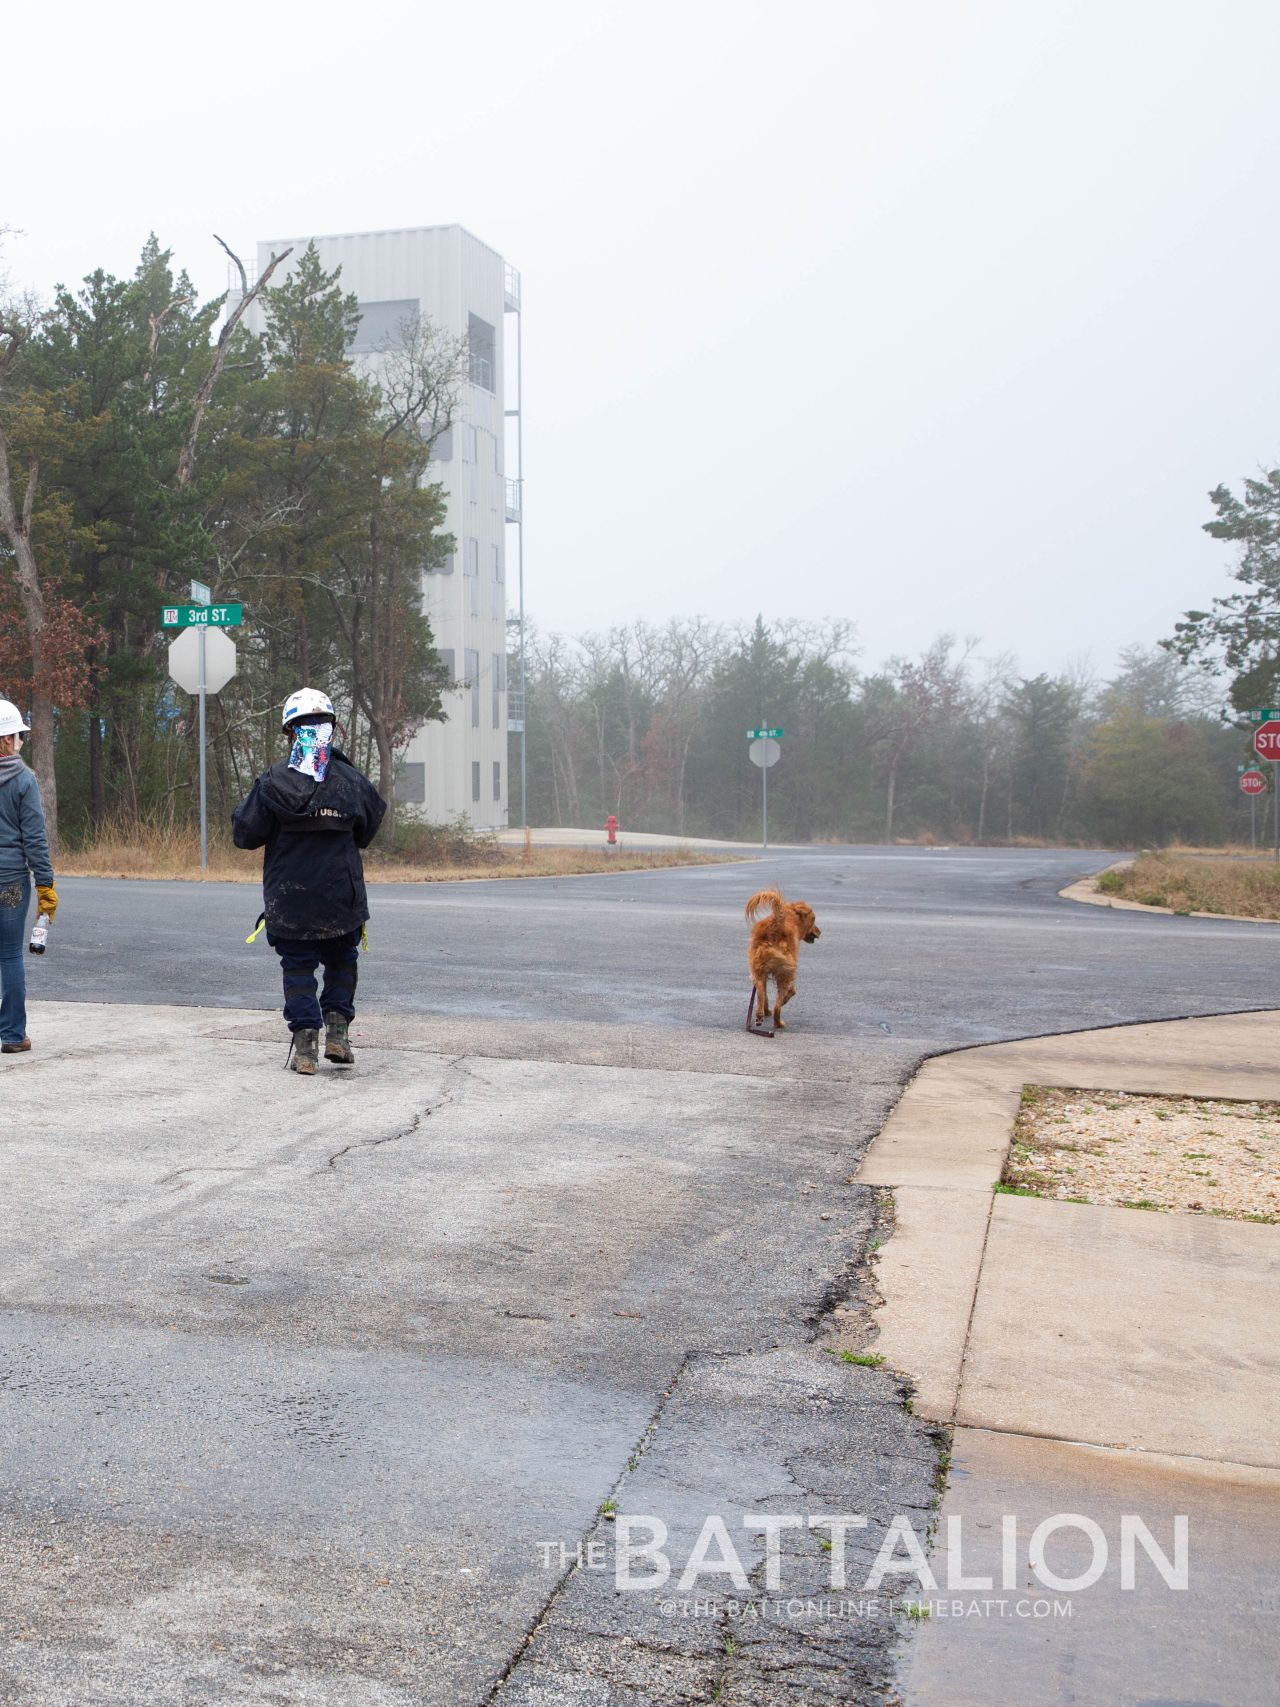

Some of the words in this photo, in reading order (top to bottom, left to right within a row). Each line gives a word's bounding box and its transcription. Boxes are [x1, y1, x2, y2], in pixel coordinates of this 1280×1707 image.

[188, 609, 208, 622] 3rd
[211, 608, 230, 621] ST.
[320, 808, 342, 818] US&
